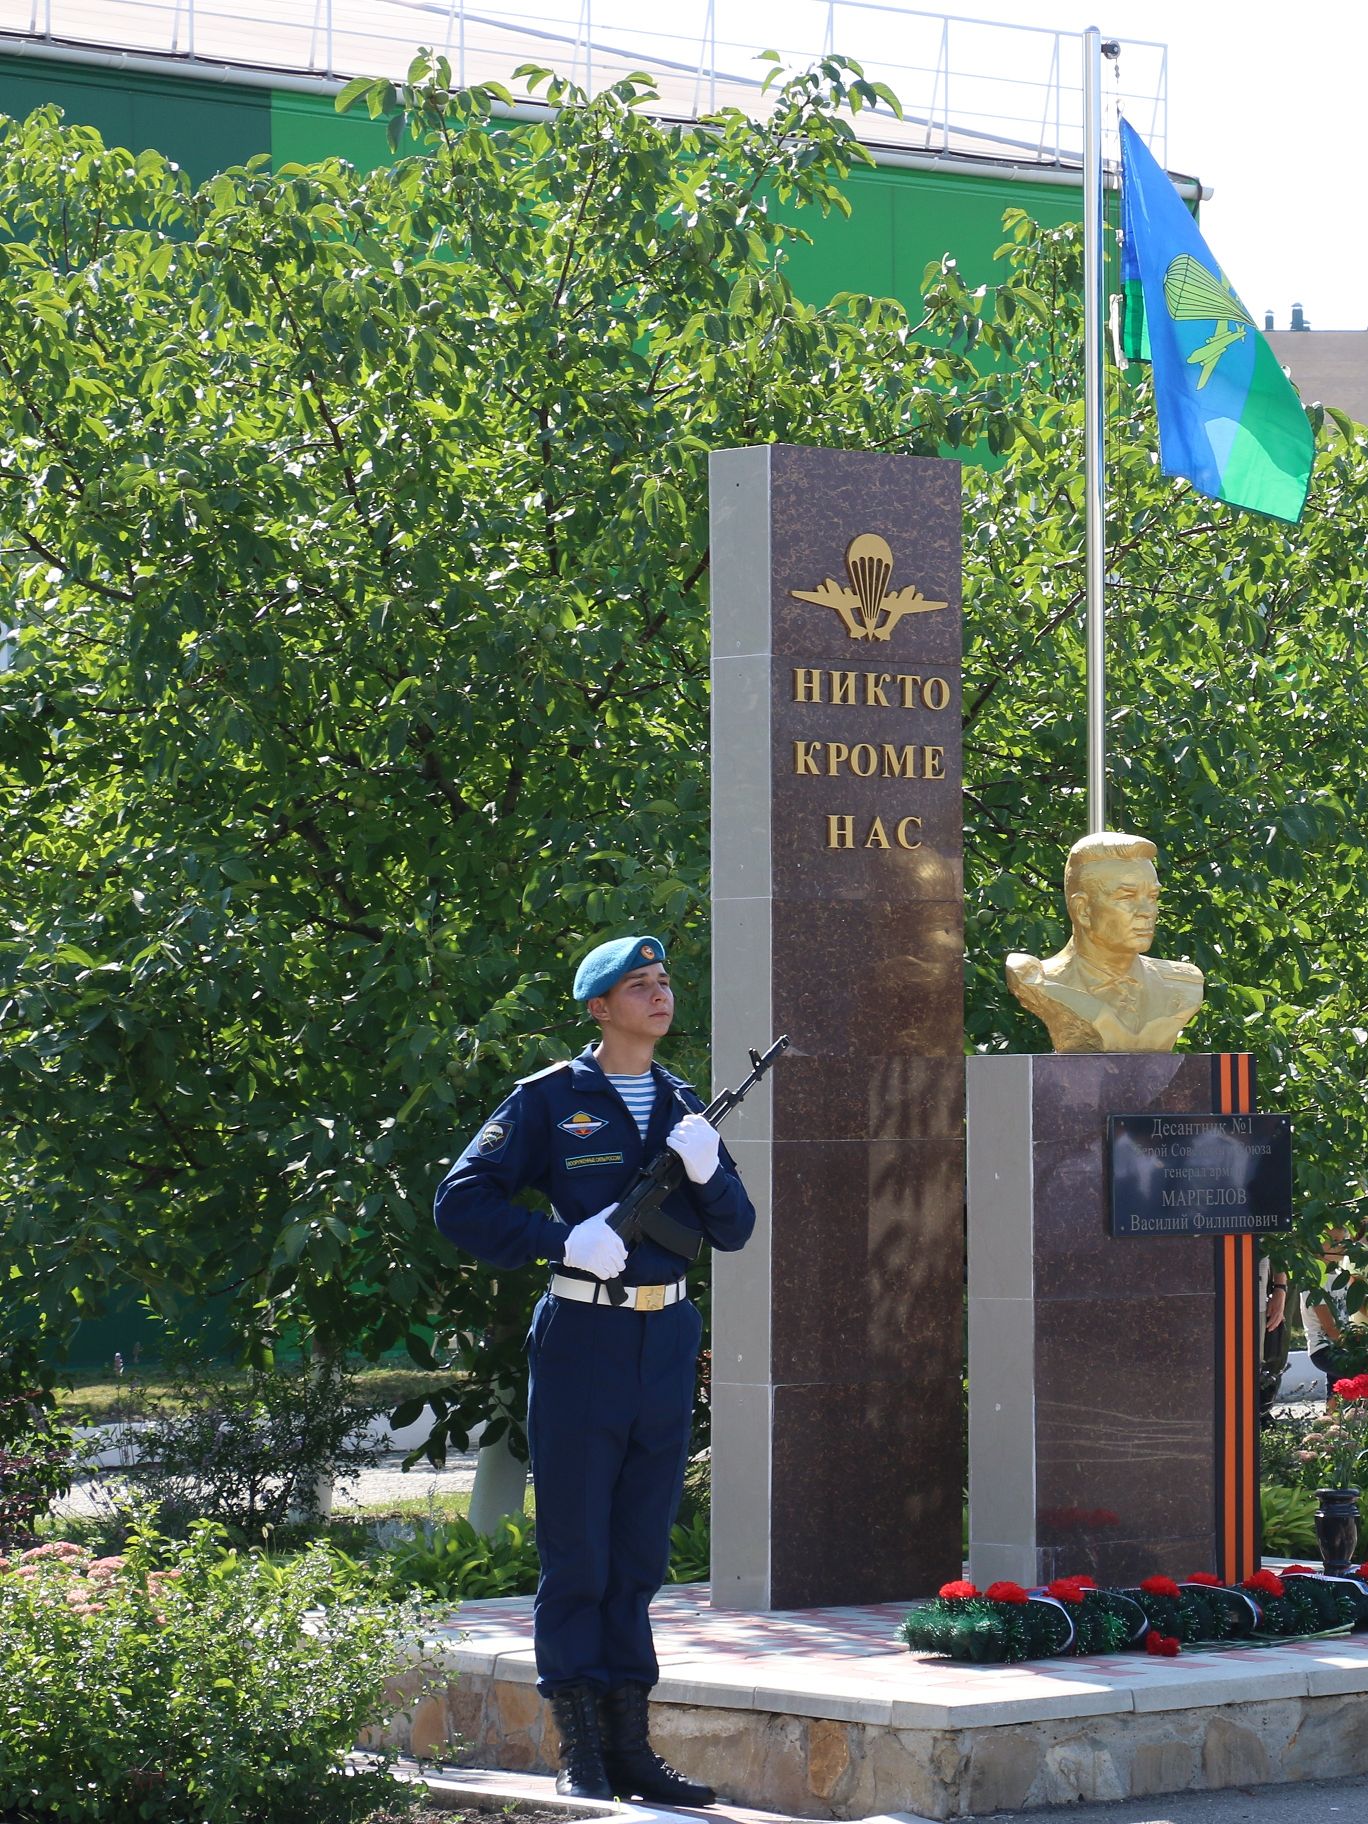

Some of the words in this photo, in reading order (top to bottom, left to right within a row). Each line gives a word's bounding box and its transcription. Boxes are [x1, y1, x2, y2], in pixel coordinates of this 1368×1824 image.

[793, 667, 951, 710] НИКТО
[794, 740, 946, 780] КРОМЕ
[826, 814, 922, 850] НАС
[1151, 1119, 1227, 1139] Десантник
[1231, 1117, 1253, 1135] №1
[1136, 1143, 1168, 1158] ерой
[1164, 1167, 1206, 1181] генерал
[1209, 1166, 1243, 1180] арм
[1162, 1188, 1247, 1207] МАРГЕЛОВ
[1131, 1214, 1188, 1231] Василий
[1193, 1213, 1278, 1230] Филиппович
